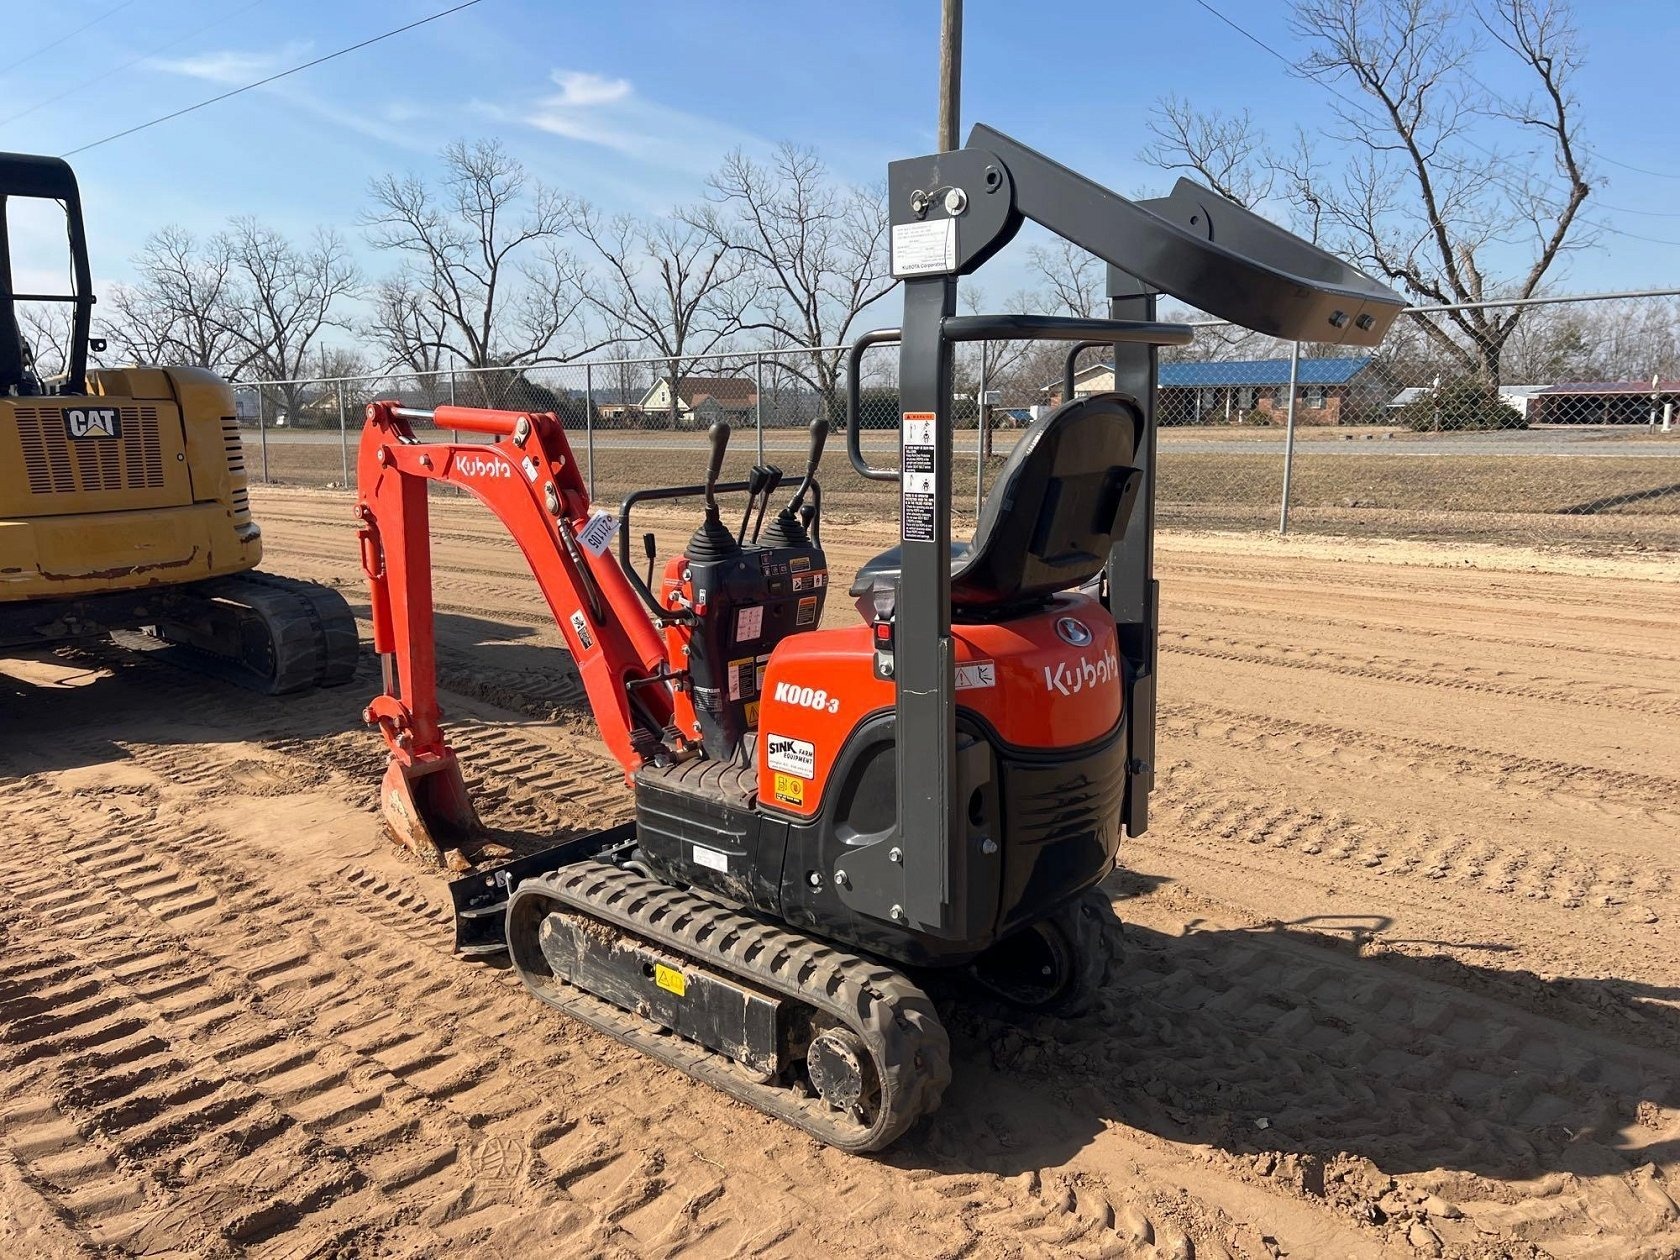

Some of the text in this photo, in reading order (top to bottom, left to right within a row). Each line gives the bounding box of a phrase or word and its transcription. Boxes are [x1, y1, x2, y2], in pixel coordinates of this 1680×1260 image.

[69, 410, 115, 437] CAT
[456, 456, 511, 478] Kubota
[588, 518, 613, 549] 211105
[1044, 649, 1119, 696] Kubota
[774, 682, 840, 714] K008-3
[769, 740, 813, 757] SINK FARM
[783, 752, 813, 765] EQUIPMENT
